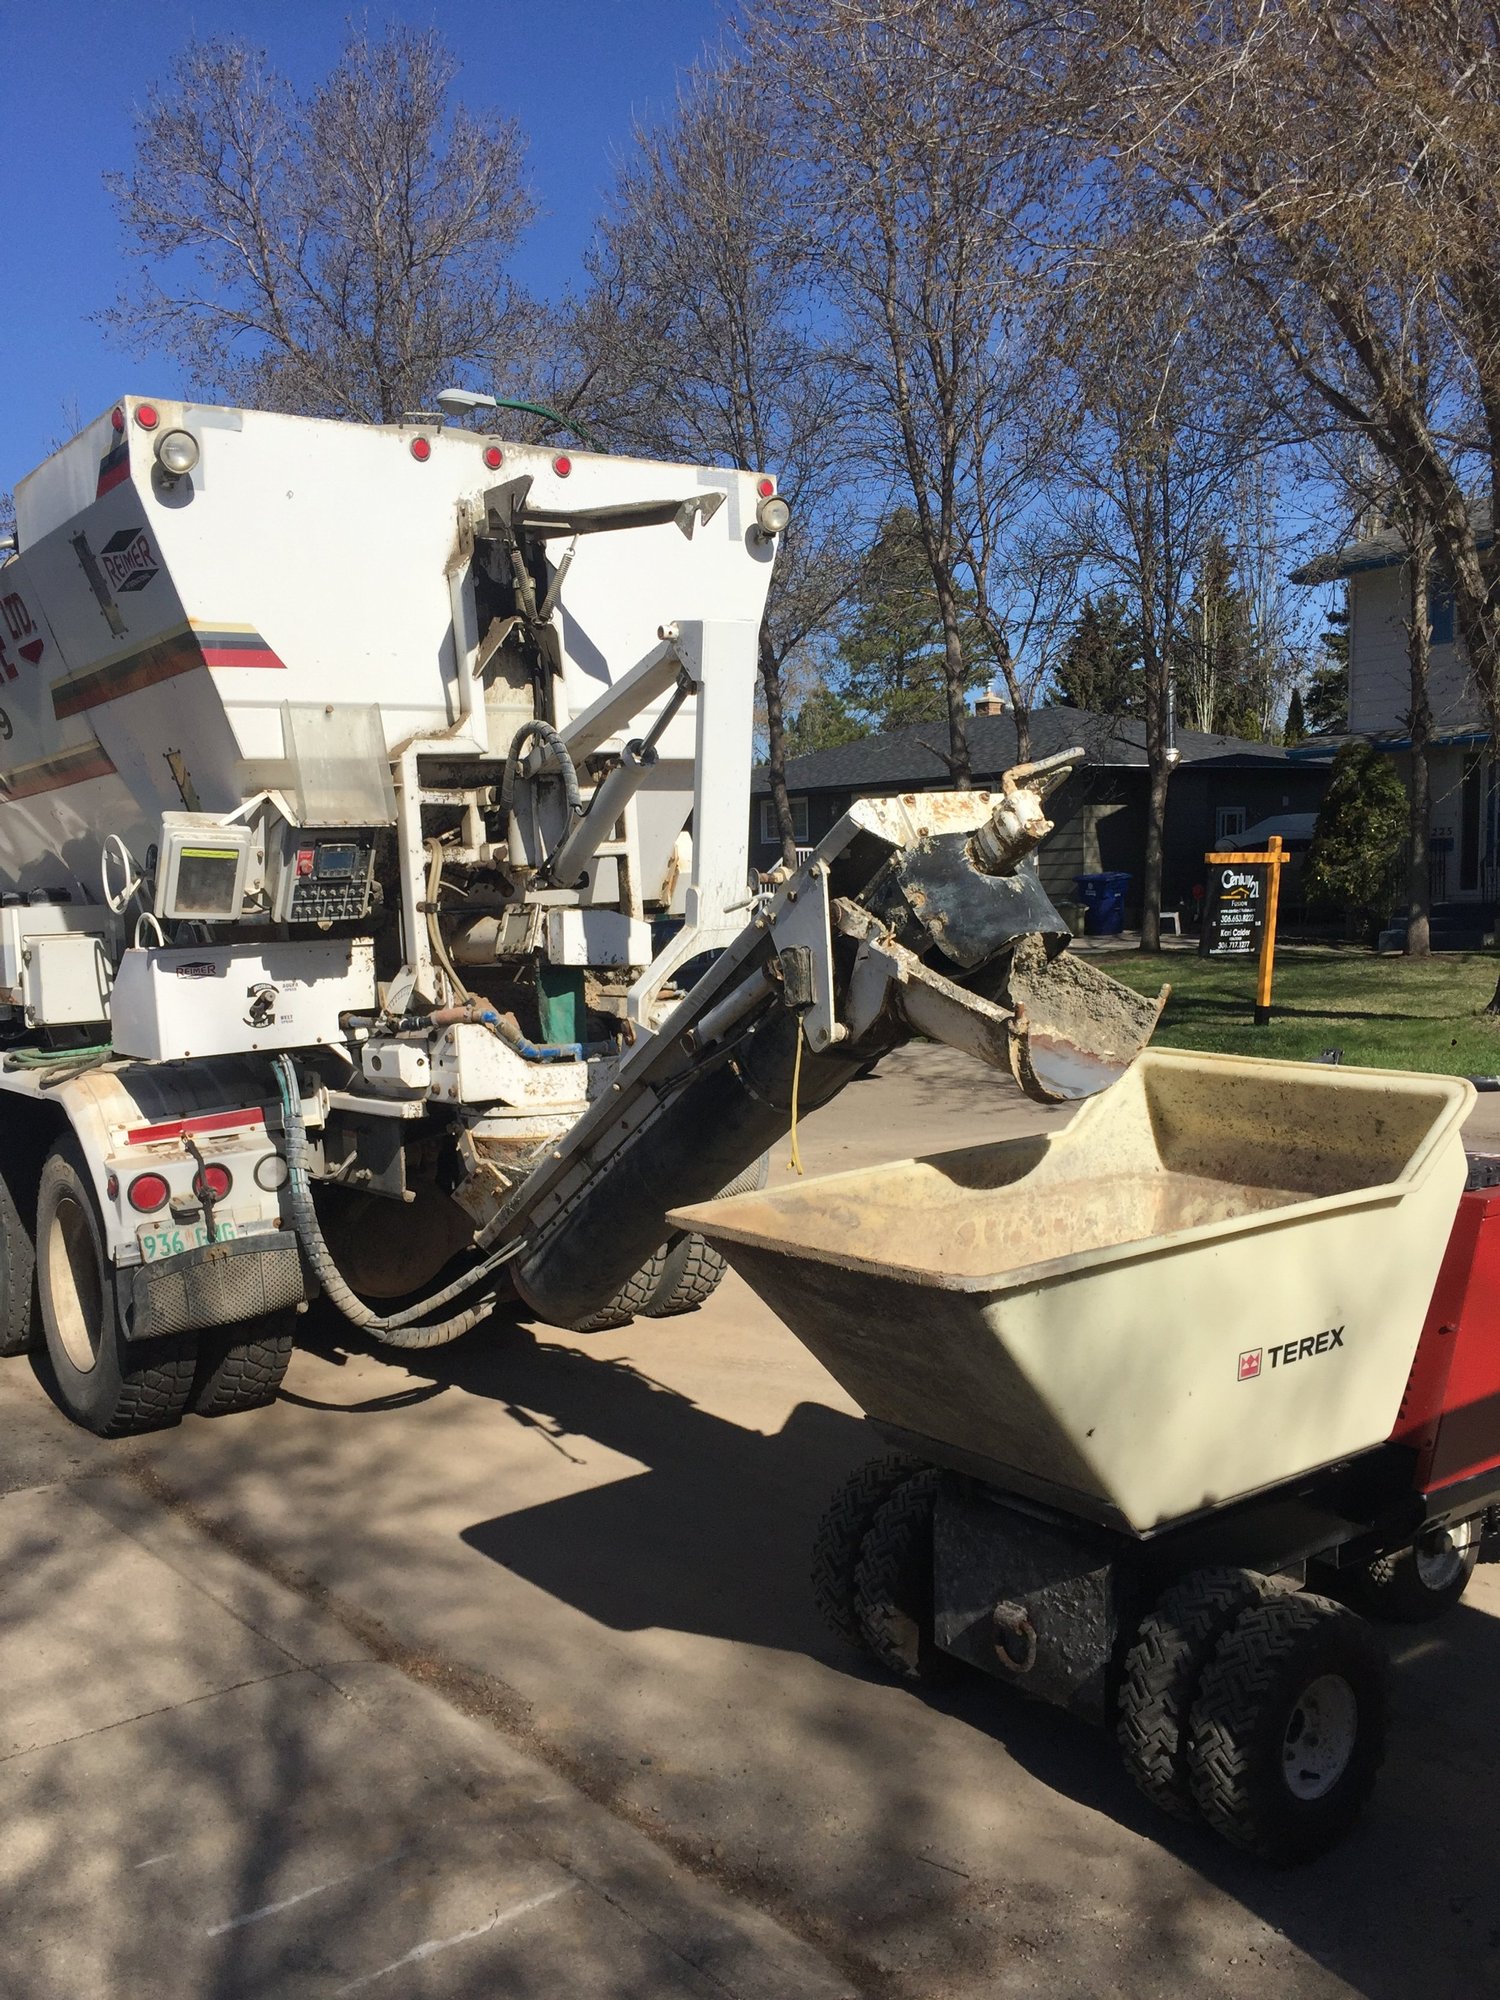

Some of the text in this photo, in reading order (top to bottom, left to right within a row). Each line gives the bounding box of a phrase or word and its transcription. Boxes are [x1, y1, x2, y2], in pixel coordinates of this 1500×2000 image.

[102, 535, 158, 589] REIMER
[1221, 869, 1259, 898] Century 21
[176, 965, 216, 977] REIMER
[143, 1231, 185, 1259] 936
[1267, 1325, 1346, 1369] TEREX
